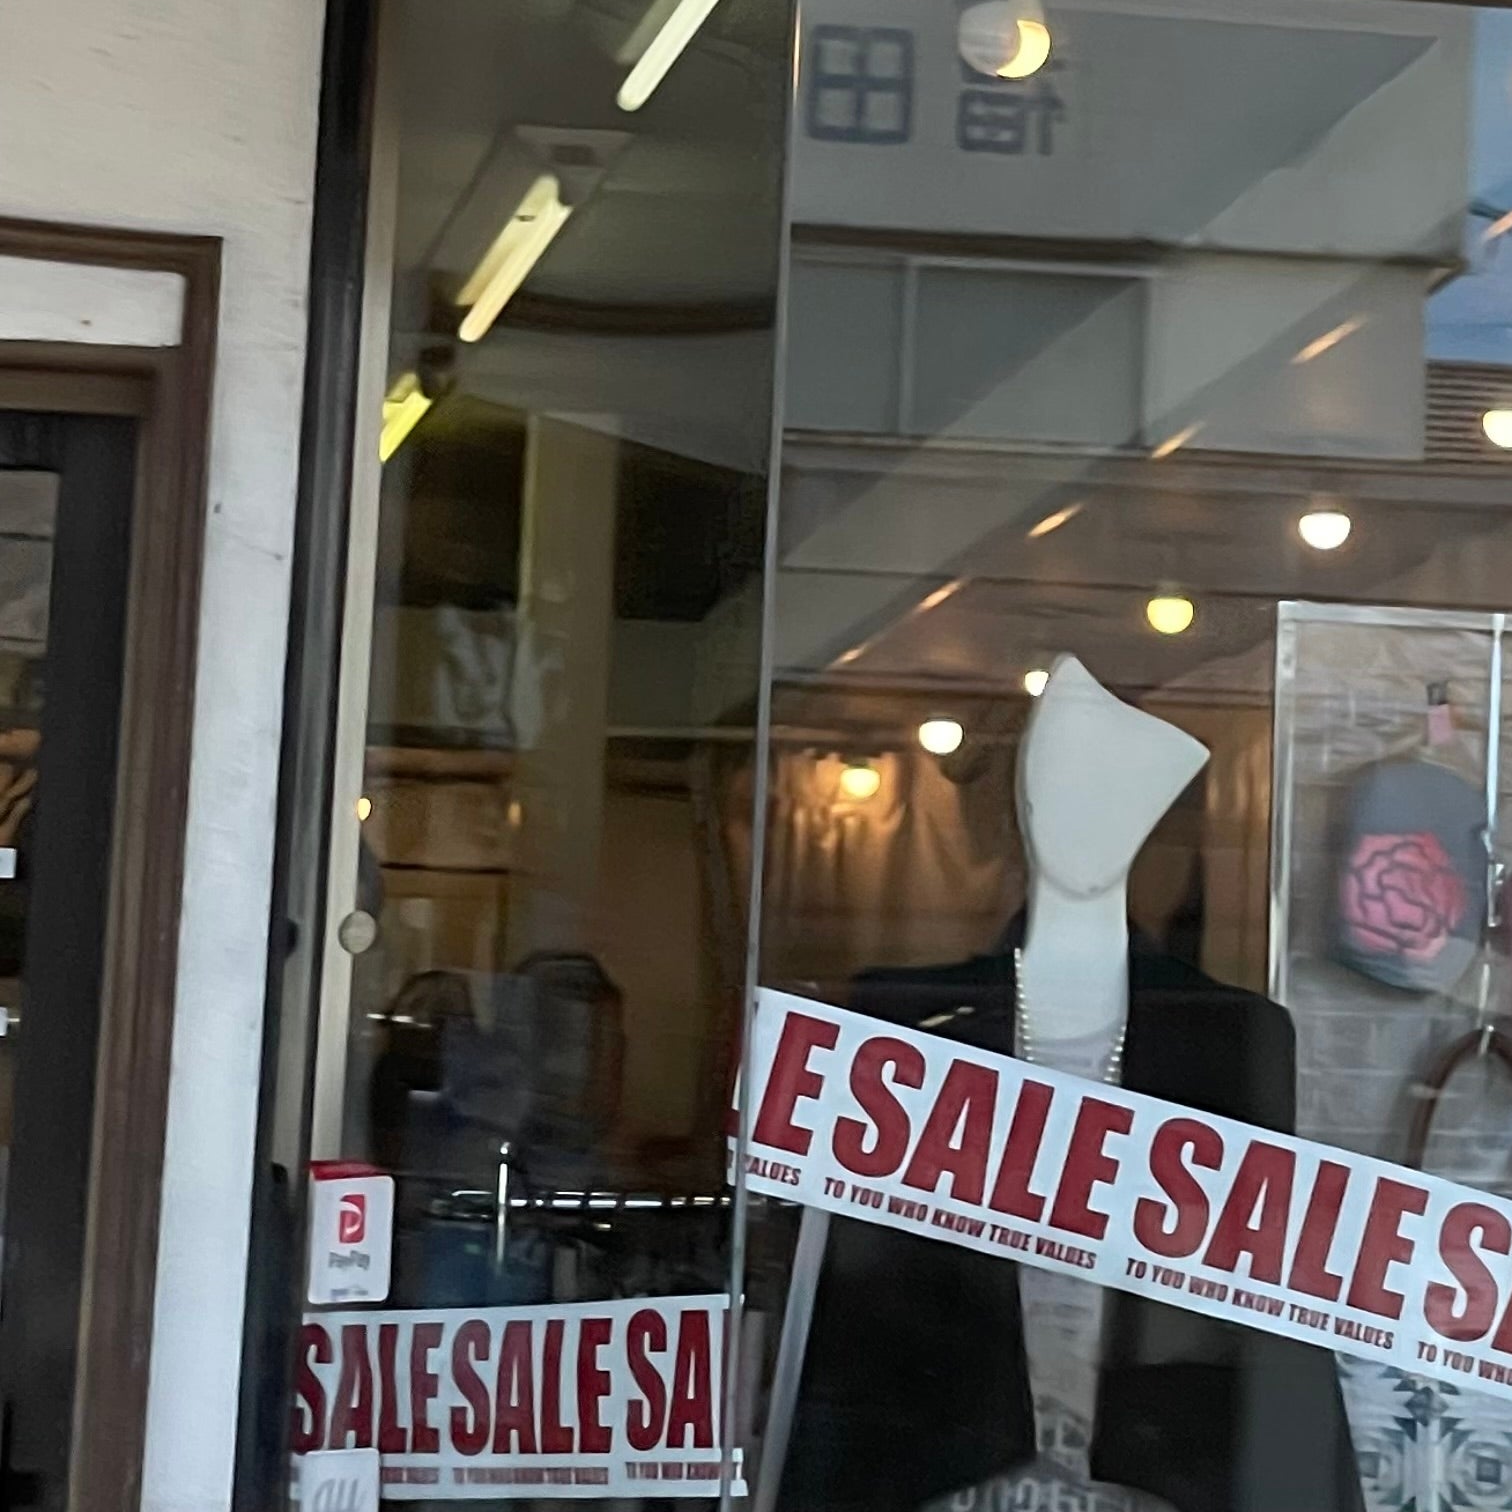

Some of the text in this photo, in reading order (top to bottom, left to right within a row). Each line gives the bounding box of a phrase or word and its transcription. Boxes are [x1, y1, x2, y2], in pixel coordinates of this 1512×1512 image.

[824, 1177, 844, 1199] TO
[850, 1183, 884, 1209] YOU
[988, 1223, 1031, 1252] TRUE
[1036, 1236, 1097, 1270] VALUES
[832, 1036, 1134, 1240] SALE
[1132, 1117, 1429, 1320] SALE
[1125, 1257, 1145, 1279] TO
[1151, 1265, 1185, 1289] YOU
[1289, 1304, 1329, 1331] TRUE
[1334, 1316, 1395, 1350] VALUES
[289, 1323, 444, 1455] SALE
[450, 1319, 612, 1456] SALE
[1416, 1341, 1437, 1363] TO
